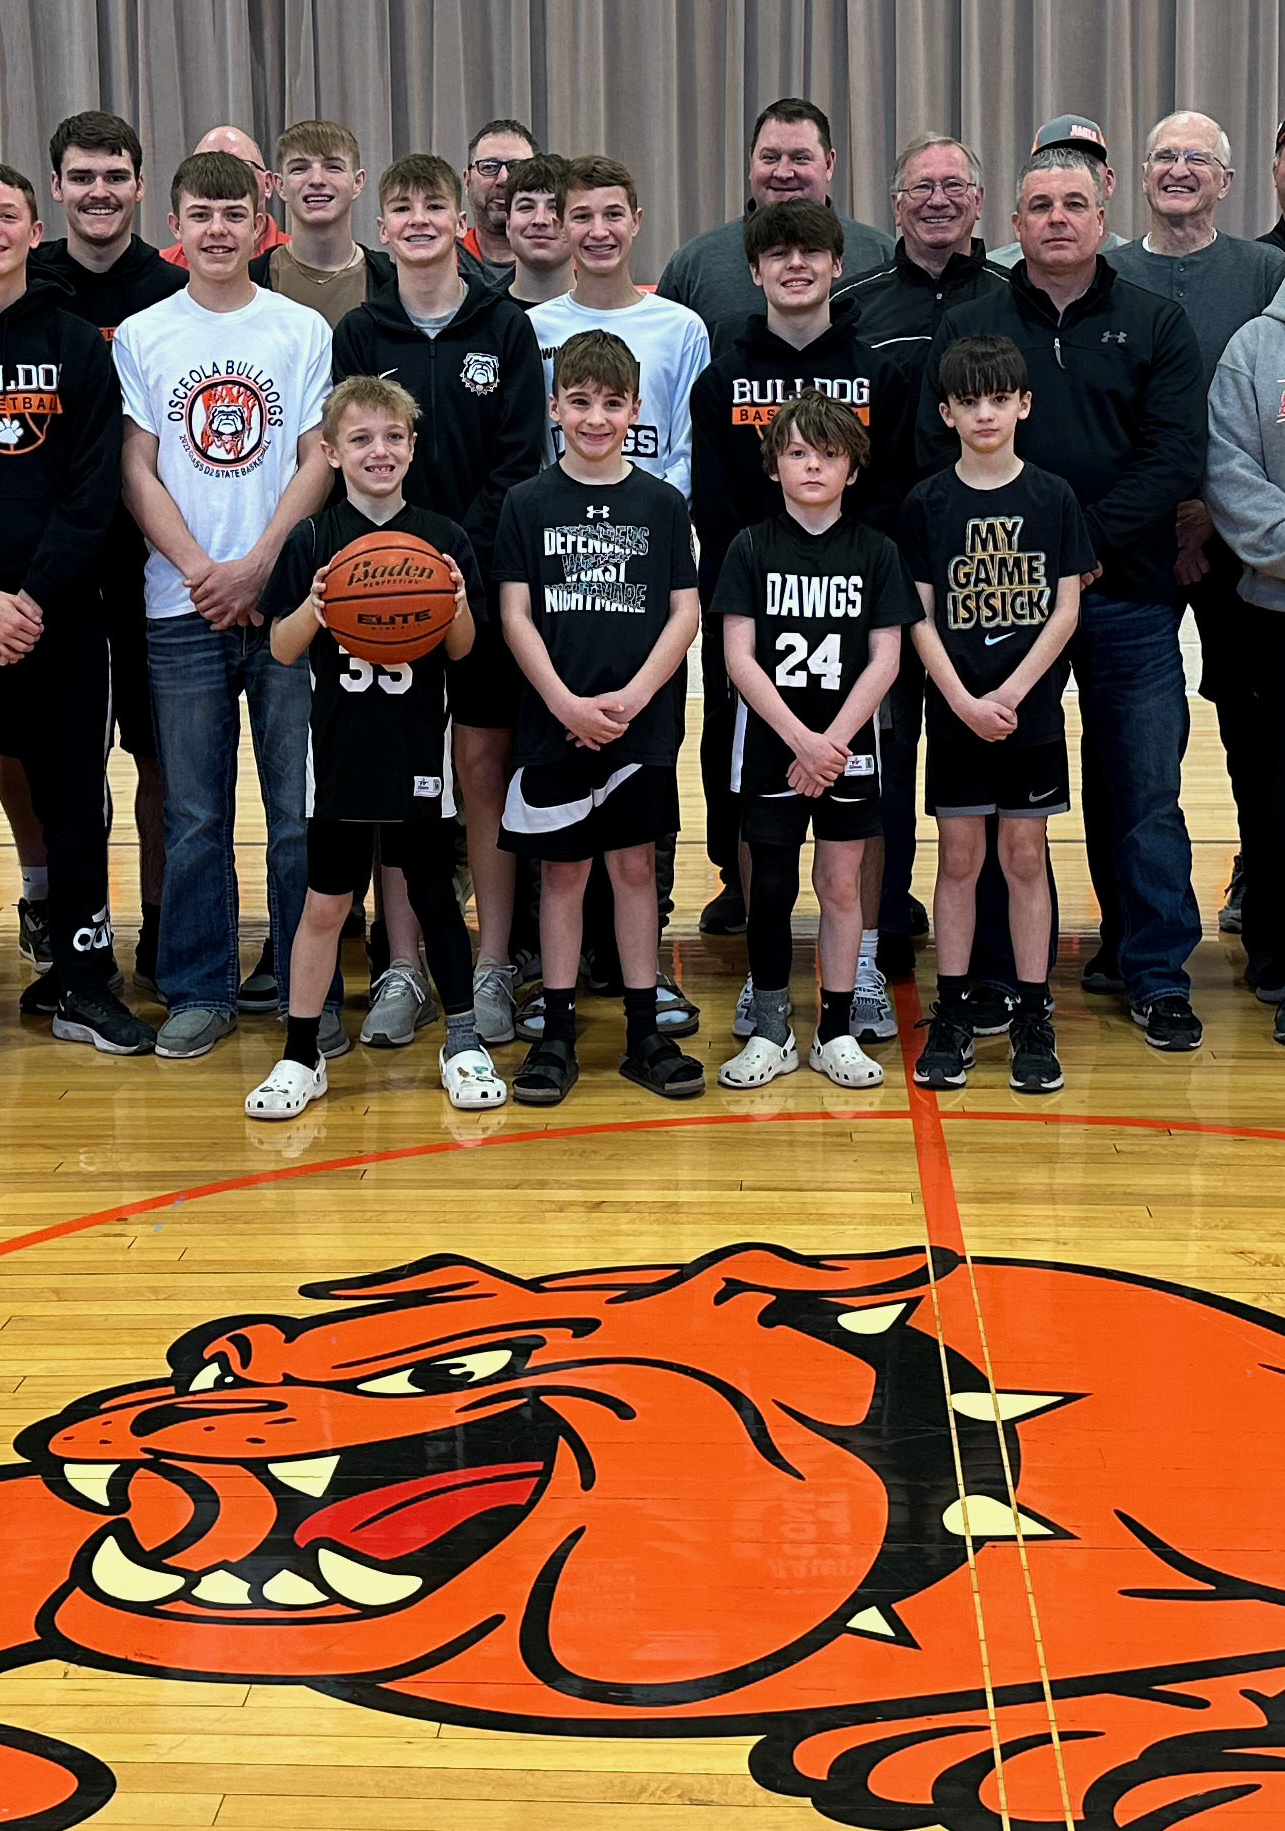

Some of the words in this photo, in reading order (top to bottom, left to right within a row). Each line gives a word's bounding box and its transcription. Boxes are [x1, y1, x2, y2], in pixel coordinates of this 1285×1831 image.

[167, 361, 222, 422] OSCEOLA
[225, 360, 284, 428] BULLDOGS
[732, 377, 871, 404] BULLDOG
[215, 469, 241, 478] STATE
[968, 518, 1022, 554] MY
[347, 557, 434, 587] Baden
[951, 553, 1045, 591] GAME
[766, 572, 863, 618] DAWGS
[950, 592, 975, 627] IS
[982, 588, 1049, 624] SICK
[357, 608, 432, 626] ELITE
[775, 632, 843, 690] 24
